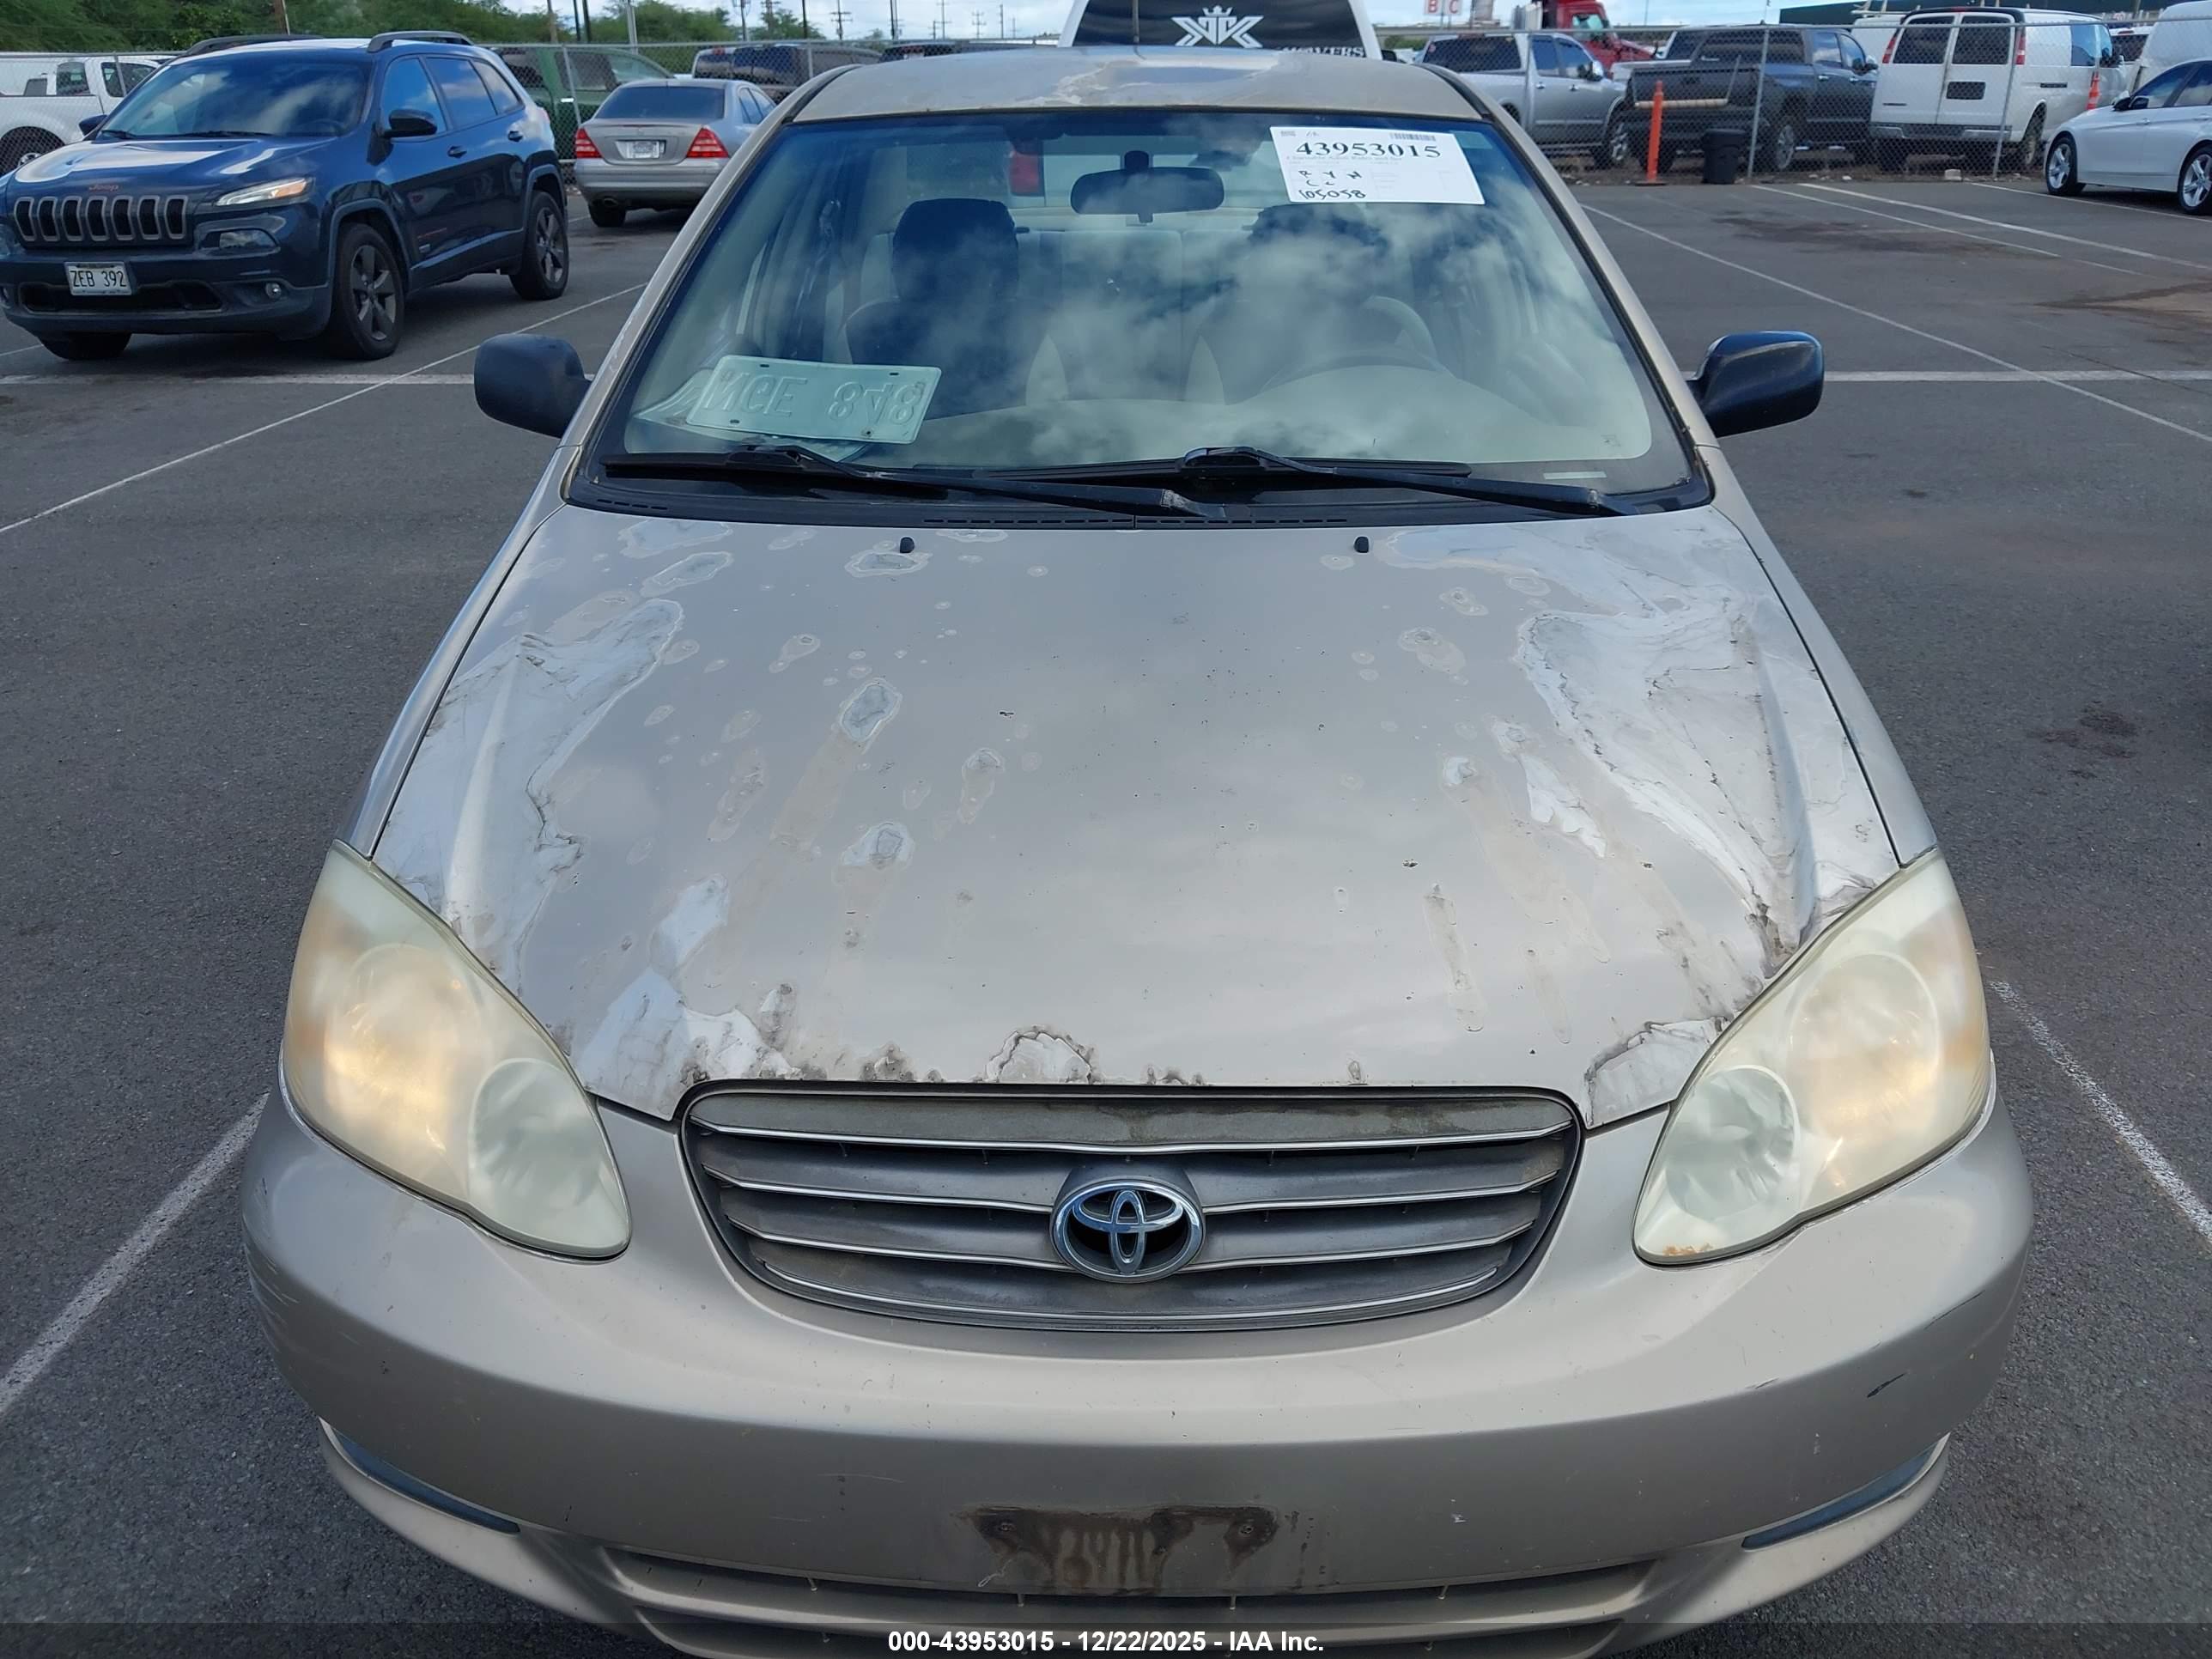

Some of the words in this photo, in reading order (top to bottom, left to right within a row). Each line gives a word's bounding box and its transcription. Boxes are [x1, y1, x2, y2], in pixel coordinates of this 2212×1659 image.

[1296, 142, 1441, 158] 43953015
[70, 270, 95, 287] ZEB
[101, 270, 127, 287] 392
